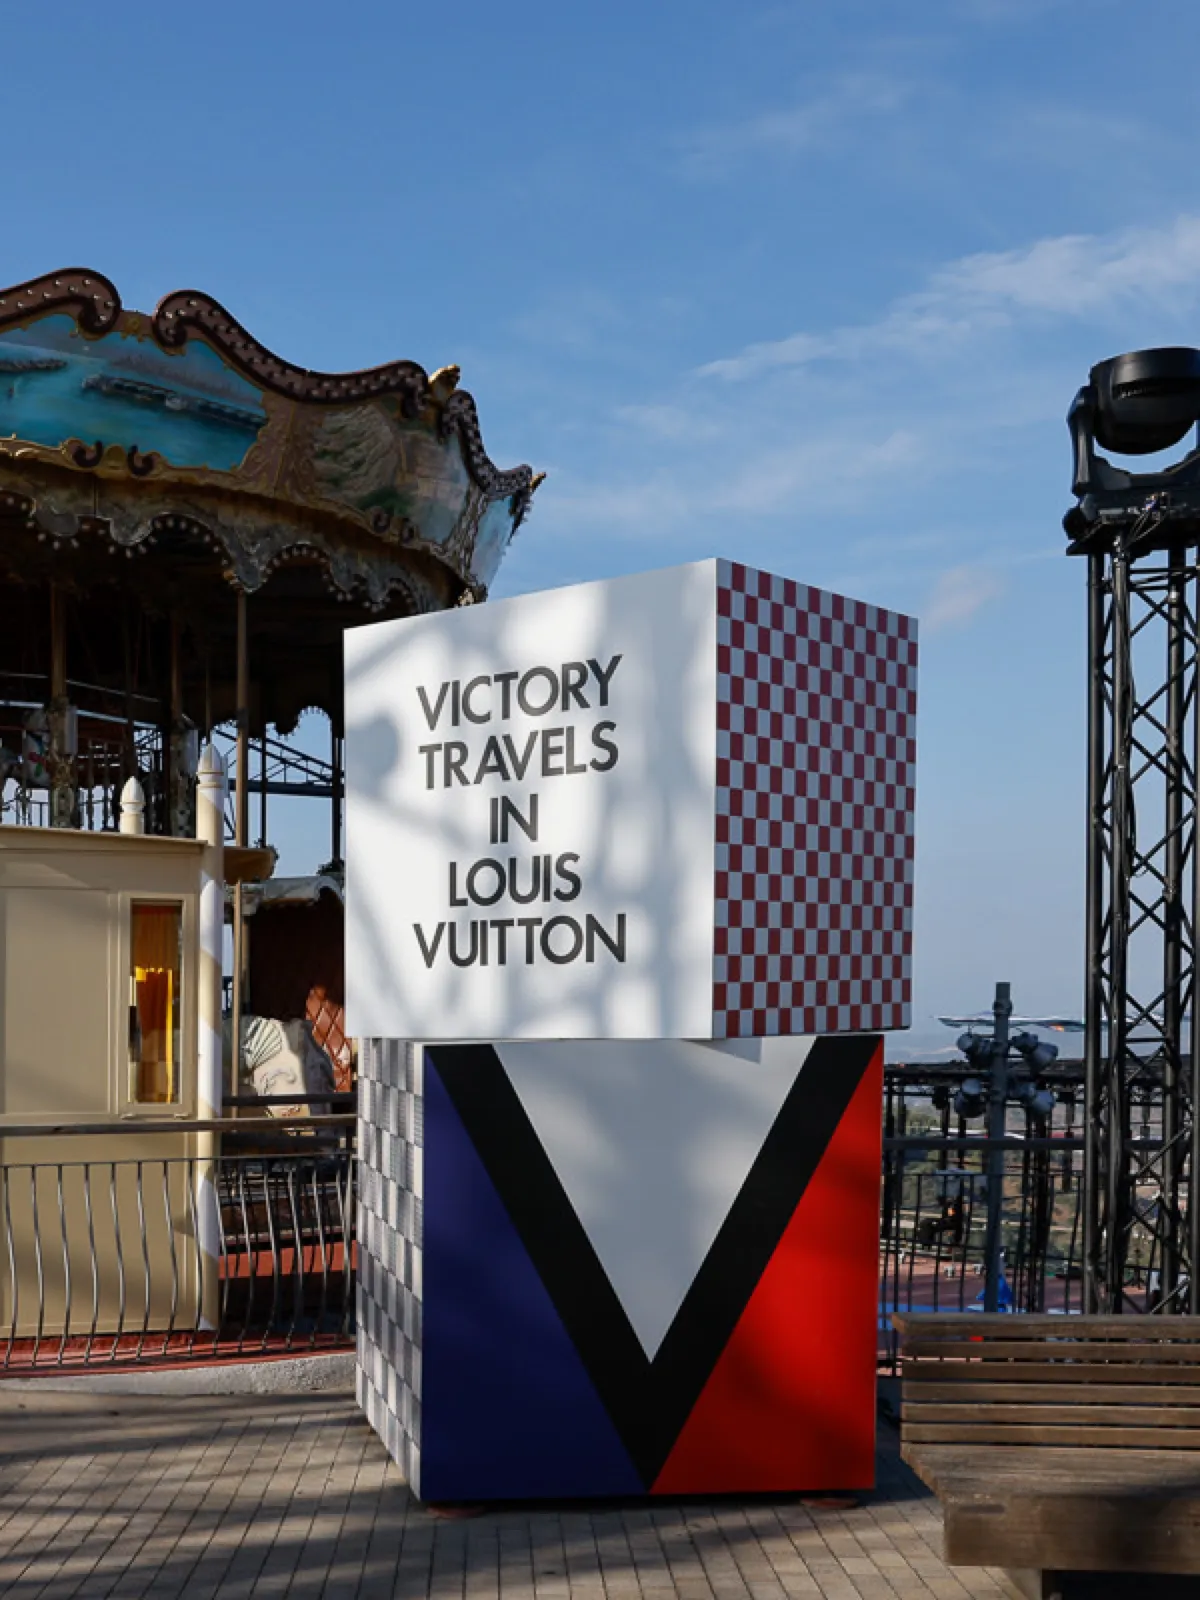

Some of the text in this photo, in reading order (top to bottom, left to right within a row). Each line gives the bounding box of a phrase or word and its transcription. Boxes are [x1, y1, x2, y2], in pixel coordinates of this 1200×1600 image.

[416, 654, 623, 731] VICTORY
[418, 720, 619, 790] TRAVELS
[490, 793, 538, 844] IN
[449, 852, 582, 907] LOUIS
[412, 913, 627, 968] VUITTON
[424, 1035, 884, 1495] V
